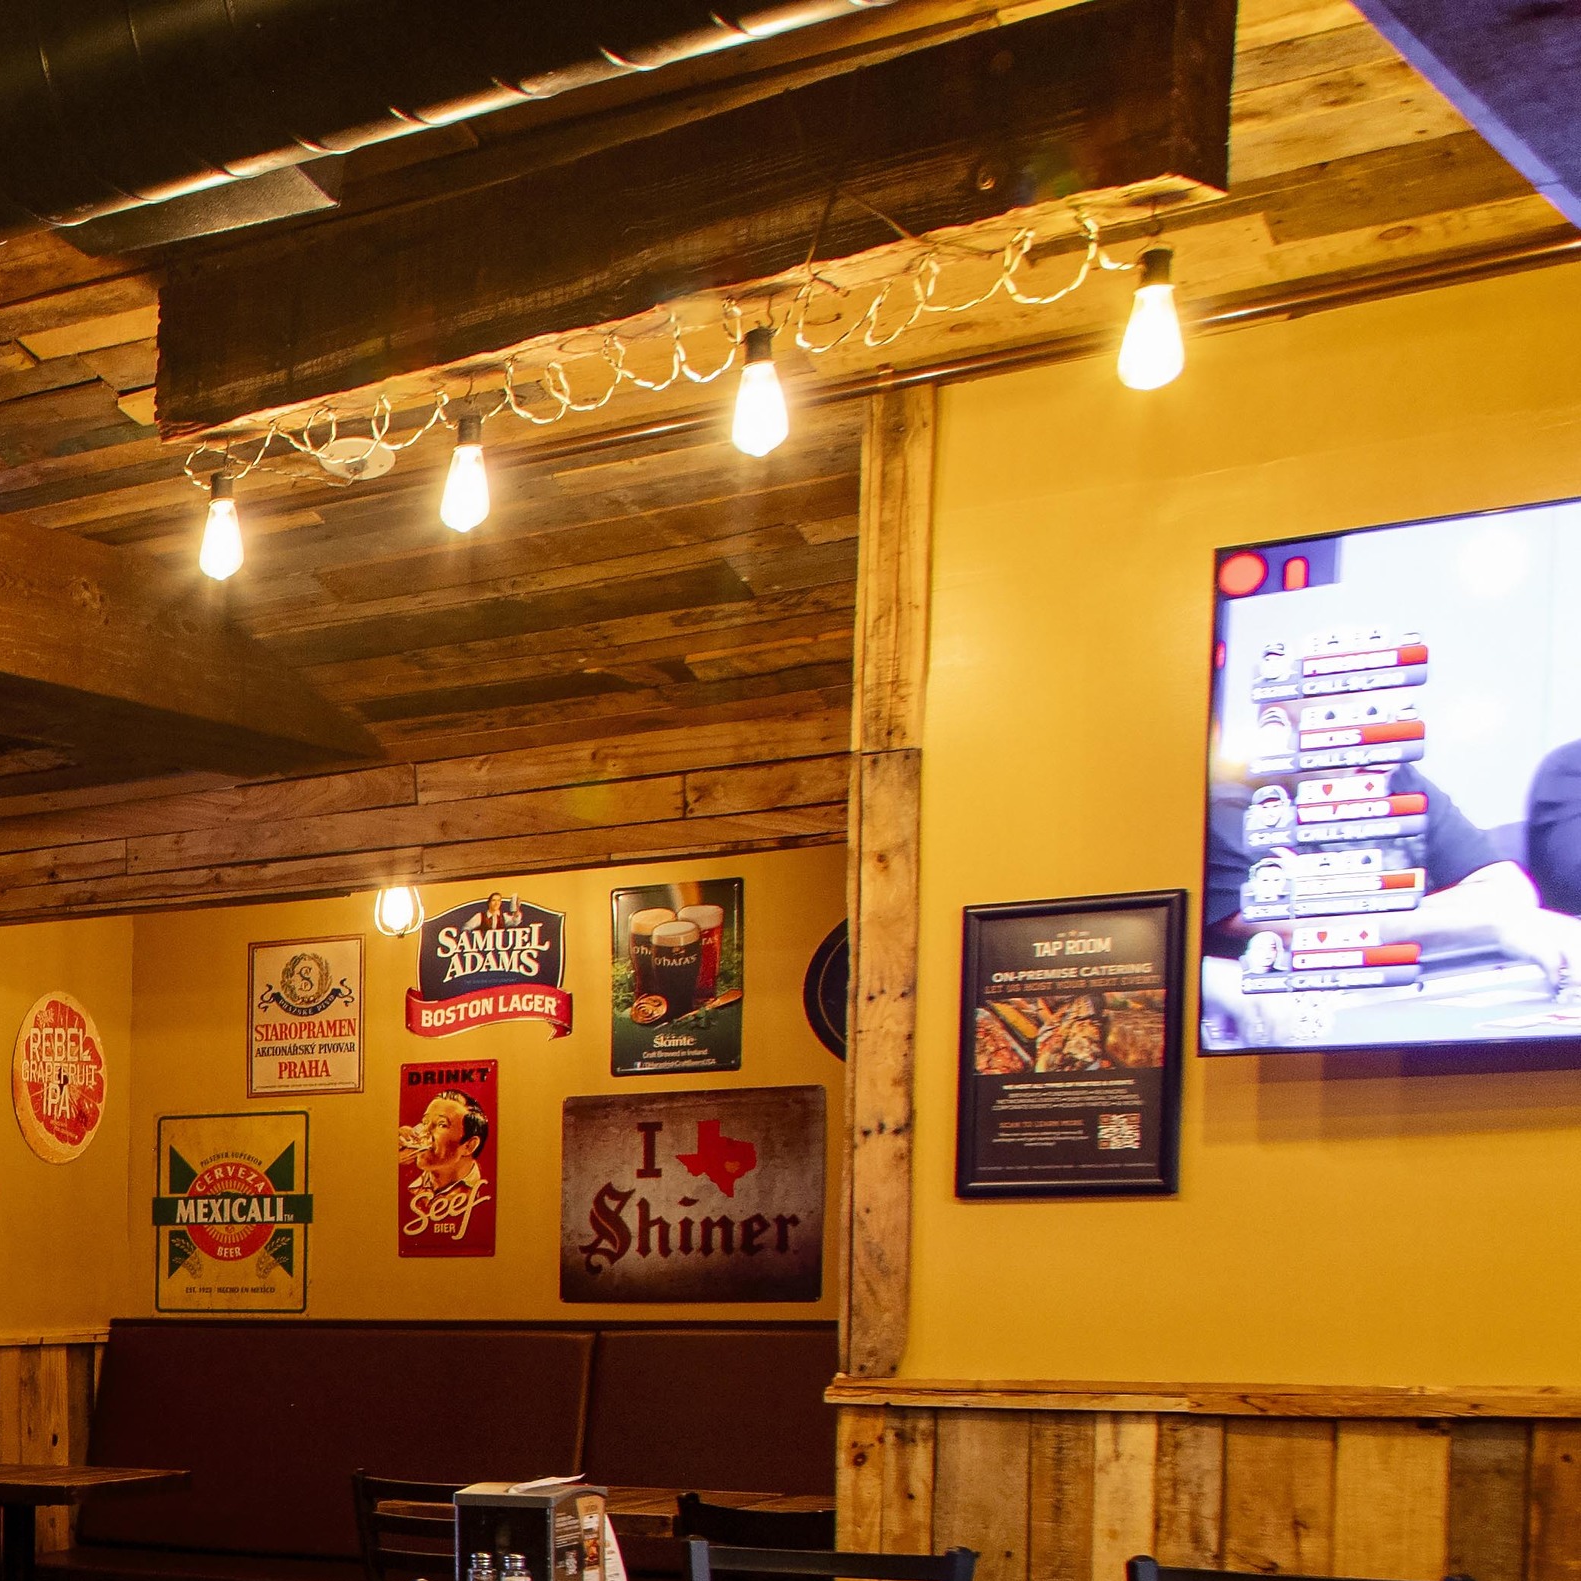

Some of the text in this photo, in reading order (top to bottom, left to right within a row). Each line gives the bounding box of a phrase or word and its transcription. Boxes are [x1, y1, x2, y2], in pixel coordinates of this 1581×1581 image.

[437, 922, 551, 958] SAMUEL
[1033, 937, 1112, 957] TAP ROOM
[443, 950, 540, 983] ADAMS
[992, 963, 1153, 983] ON-PREMISE CATERING
[421, 994, 556, 1027] BOSTON LAGER
[255, 1018, 357, 1041] STAROPRAMEN
[30, 1028, 91, 1062] REBEL
[319, 1042, 355, 1054] PIVOVAR
[22, 1060, 97, 1086] GRAPEFRUIT
[278, 1059, 331, 1079] PRAHA
[407, 1067, 491, 1087] DRINKT
[43, 1082, 70, 1120] IPA
[636, 1122, 663, 1179] I
[196, 1166, 265, 1193] CERVEZA
[176, 1197, 283, 1223] MEXICALI
[404, 1178, 492, 1240] Seef
[434, 1222, 456, 1234] BIER
[578, 1182, 800, 1274] Shiner
[217, 1247, 241, 1258] BEER
